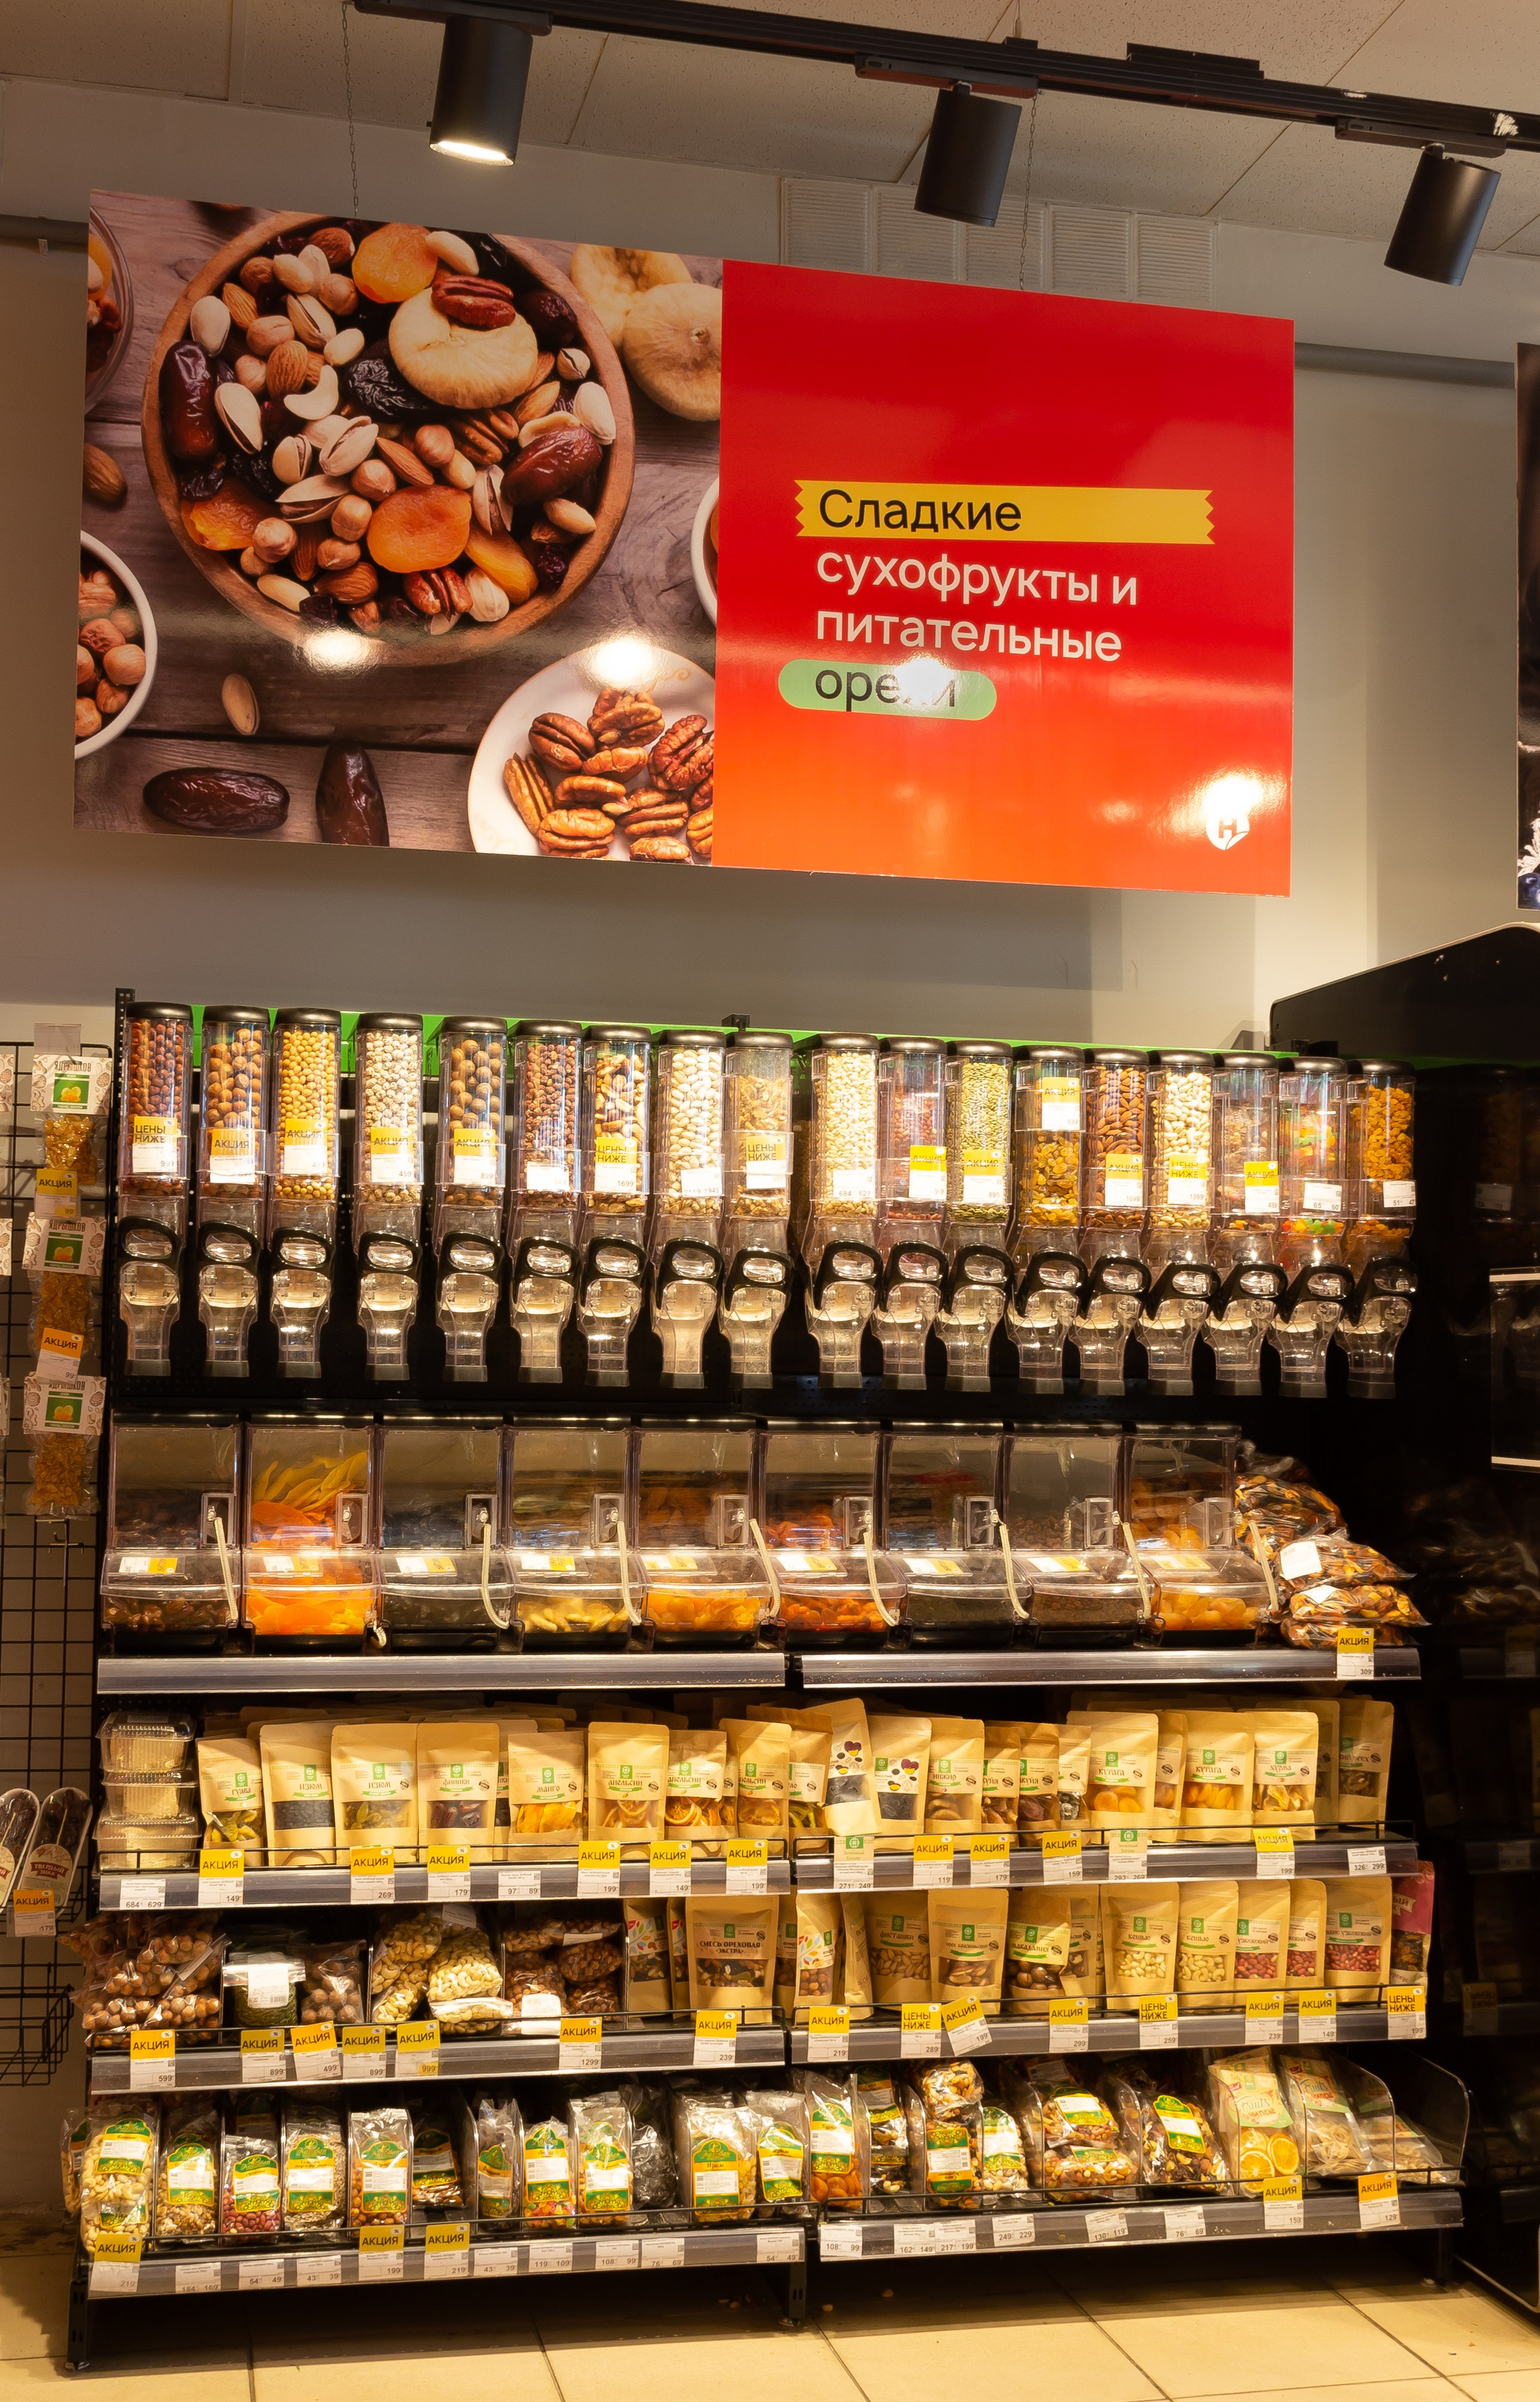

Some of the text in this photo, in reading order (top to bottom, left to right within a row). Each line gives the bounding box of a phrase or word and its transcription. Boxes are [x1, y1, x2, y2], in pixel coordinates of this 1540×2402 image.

[819, 488, 1021, 533] Сладкие
[817, 552, 1138, 607] сухофрукты и
[817, 610, 1123, 662] питательные
[135, 1124, 166, 1135] ЦЕНЫ
[135, 1134, 165, 1144] НИЖЕ
[287, 1130, 321, 1139] АКЦИЯ
[214, 1139, 249, 1150] АКЦИЯ
[374, 1137, 408, 1146] АКЦИЯ
[456, 1139, 490, 1148] АКЦИЯ
[748, 1144, 776, 1153] ЦЕНЫ
[597, 1154, 626, 1163] НИЖЕ
[913, 1154, 943, 1163] АКЦИЯ
[967, 1159, 999, 1168] АКЦИЯ
[1247, 1171, 1275, 1179] АКЦИЯ
[38, 1178, 72, 1189] АКЦИЯ
[44, 1336, 78, 1350] АКЦИЯ
[1339, 1637, 1369, 1646] АКЦИЯ
[1257, 1835, 1289, 1844] АКЦИЯ
[916, 1844, 949, 1853] АКЦИЯ
[973, 1843, 1005, 1852] АКЦИЯ
[1046, 1840, 1077, 1850] АКЦИЯ
[581, 1851, 615, 1861] АКЦИЯ
[653, 1852, 686, 1861] АКЦИЯ
[728, 1849, 762, 1858] АКЦИЯ
[354, 1858, 388, 1867] АКЦИЯ
[430, 1855, 464, 1865] АКЦИЯ
[203, 1860, 238, 1870] АКЦИЯ
[16, 1897, 49, 1905] АКЦИЯ
[1389, 1995, 1415, 2003] ЦЕНЫ
[1141, 2002, 1168, 2012] ЦЕНЫ
[1249, 2002, 1280, 2010] АКЦИЯ
[1301, 2000, 1332, 2009] АКЦИЯ
[904, 2012, 931, 2020] ЦЕНЫ
[946, 2004, 978, 2023] АКЦИЯ
[1052, 2008, 1083, 2018] АКЦИЯ
[1141, 2011, 1168, 2020] НИЖЕ
[812, 2016, 844, 2025] АКЦИЯ
[904, 2021, 931, 2029] НИЖЕ
[698, 2021, 732, 2030] АКЦИЯ
[562, 2027, 596, 2036] АКЦИЯ
[295, 2031, 330, 2047] АКЦИЯ
[344, 2036, 380, 2046] АКЦИЯ
[399, 2031, 434, 2044] АКЦИЯ
[976, 2033, 988, 2042] 199
[133, 2040, 169, 2050] АКЦИЯ
[242, 2039, 278, 2049] АКЦИЯ
[1241, 2097, 1270, 2112] Fruits
[1265, 2186, 1297, 2197] АКЦИЯ
[1361, 2181, 1392, 2193] АКЦИЯ
[362, 2236, 398, 2246] АКЦИЯ
[428, 2234, 464, 2244] АКЦИЯ
[98, 2244, 135, 2254] АКЦИЯ
